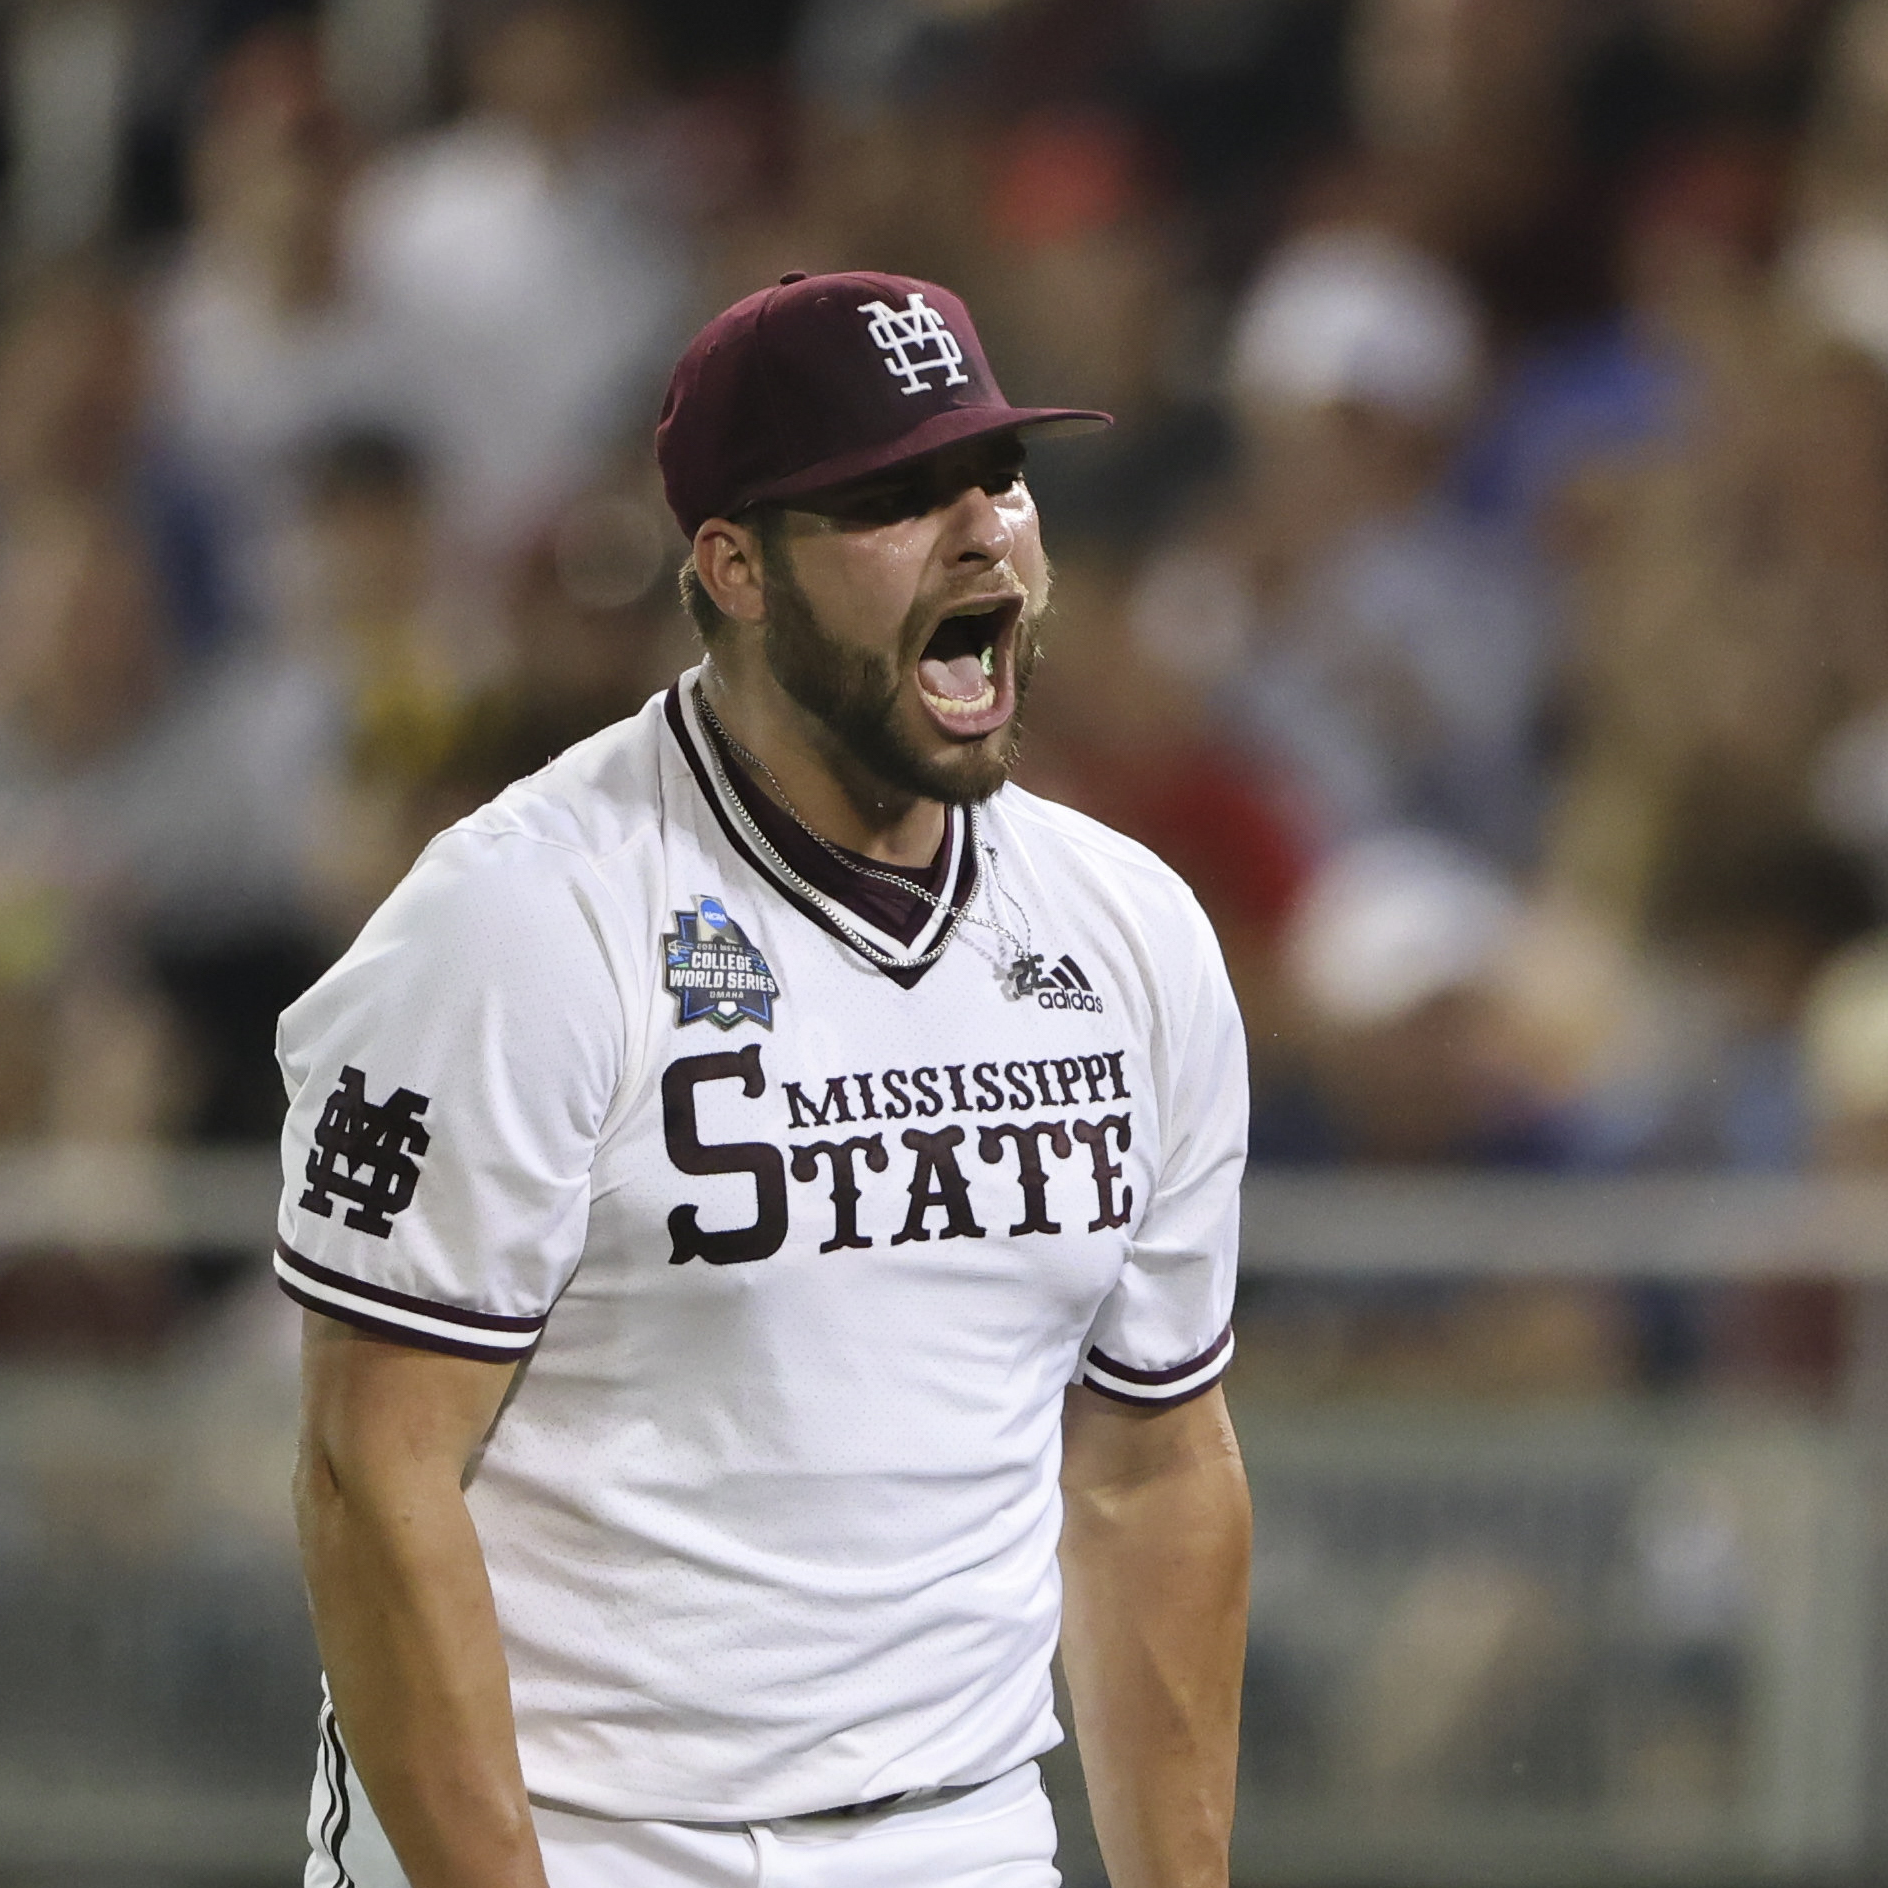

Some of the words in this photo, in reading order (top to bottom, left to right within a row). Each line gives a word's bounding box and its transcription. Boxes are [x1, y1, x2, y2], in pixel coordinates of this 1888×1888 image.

[691, 951, 753, 972] COLLEGE
[669, 969, 724, 988] WORLD
[727, 971, 776, 992] SERIES
[709, 991, 744, 999] OMAHA
[1038, 987, 1103, 1013] adidas
[782, 1050, 1131, 1129] MISSISSIPPI
[662, 1044, 1133, 1265] STATE
